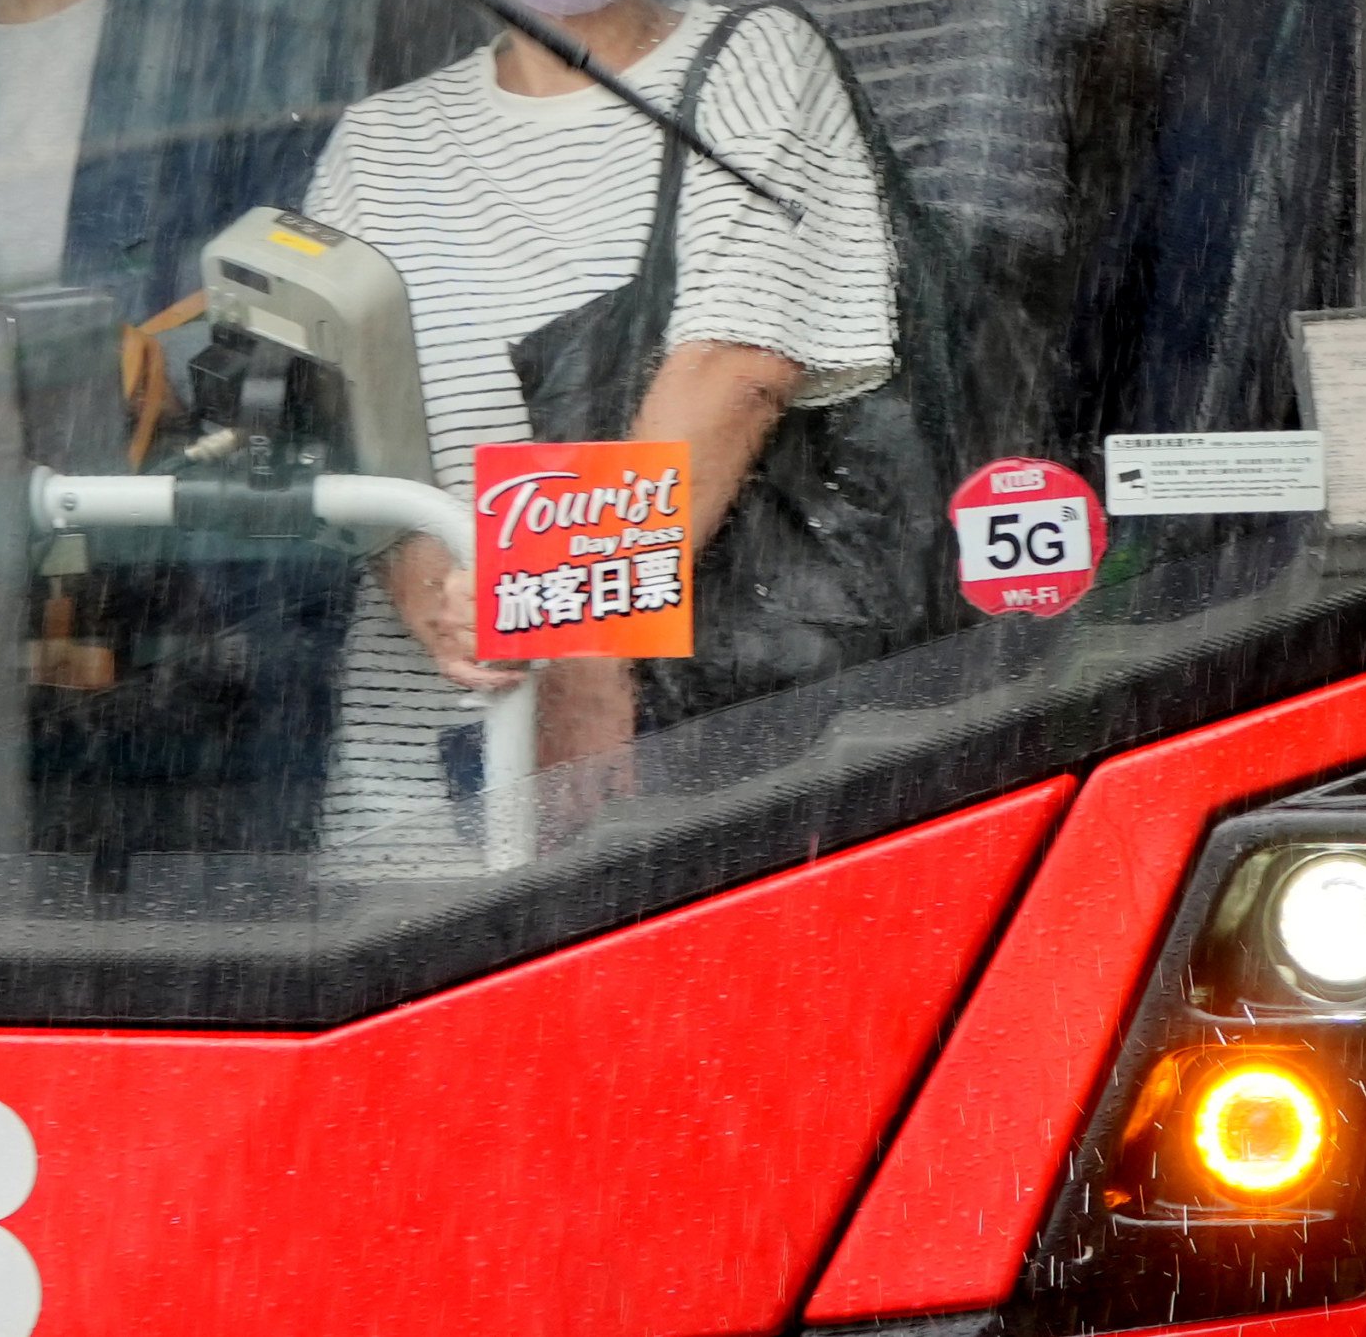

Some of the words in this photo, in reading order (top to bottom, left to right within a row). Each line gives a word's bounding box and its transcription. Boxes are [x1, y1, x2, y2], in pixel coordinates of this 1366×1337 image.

[477, 468, 681, 549] Tourist
[569, 534, 620, 557] Day
[620, 526, 684, 549] Pass
[987, 513, 1065, 571] 5G
[493, 547, 683, 635] 旅客日票
[1002, 586, 1059, 607] Wi-Fi
